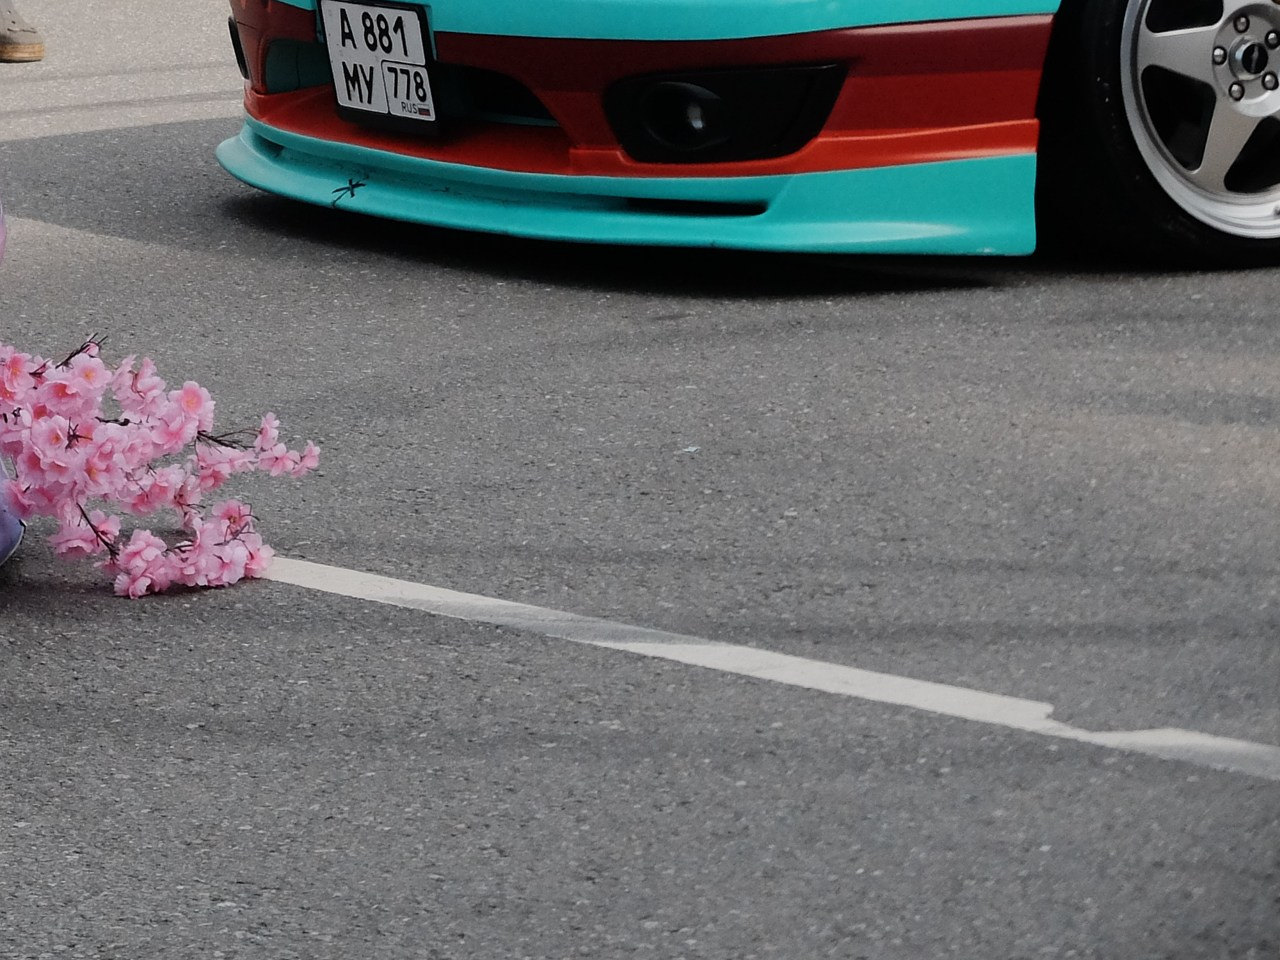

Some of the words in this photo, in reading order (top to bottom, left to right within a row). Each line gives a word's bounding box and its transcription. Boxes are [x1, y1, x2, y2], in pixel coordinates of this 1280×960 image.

[340, 8, 357, 49] A
[362, 11, 408, 57] 881
[342, 61, 374, 105] MY
[387, 67, 427, 102] 778
[401, 101, 418, 114] RUS
